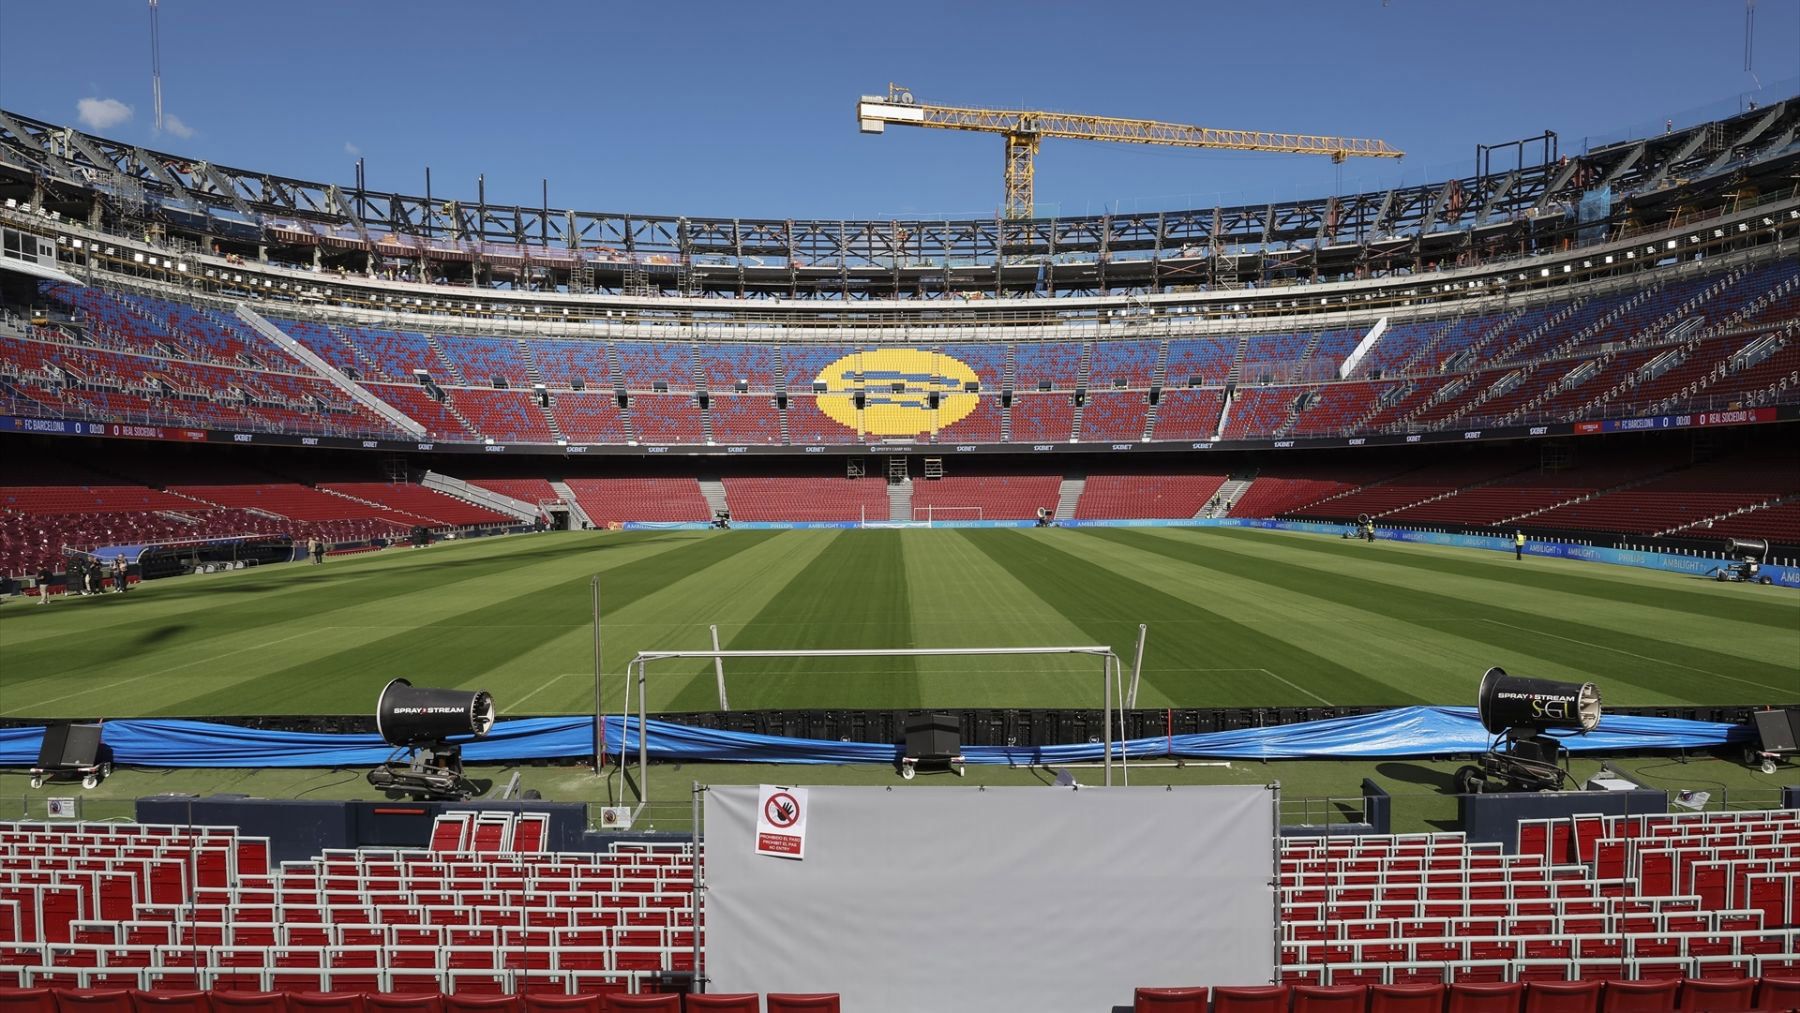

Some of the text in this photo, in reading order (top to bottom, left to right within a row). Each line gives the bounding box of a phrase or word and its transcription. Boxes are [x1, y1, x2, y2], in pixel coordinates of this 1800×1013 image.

[1621, 410, 1747, 429] FC BARCELONA 0 00:00 0 REAL SOCIEDAD
[24, 419, 33, 430] FC
[33, 420, 65, 432] BARCELONA
[75, 422, 82, 434] 0
[113, 424, 120, 436] 0
[122, 426, 133, 436] REAL
[134, 426, 156, 438] SOCIEDAD
[1529, 544, 1556, 554] AMBILIGHT
[1567, 547, 1594, 558] AMBILIGHT
[1618, 551, 1646, 564] PHILIPS
[1663, 557, 1700, 571] AMBILIGHT
[1534, 694, 1575, 702] STREAM
